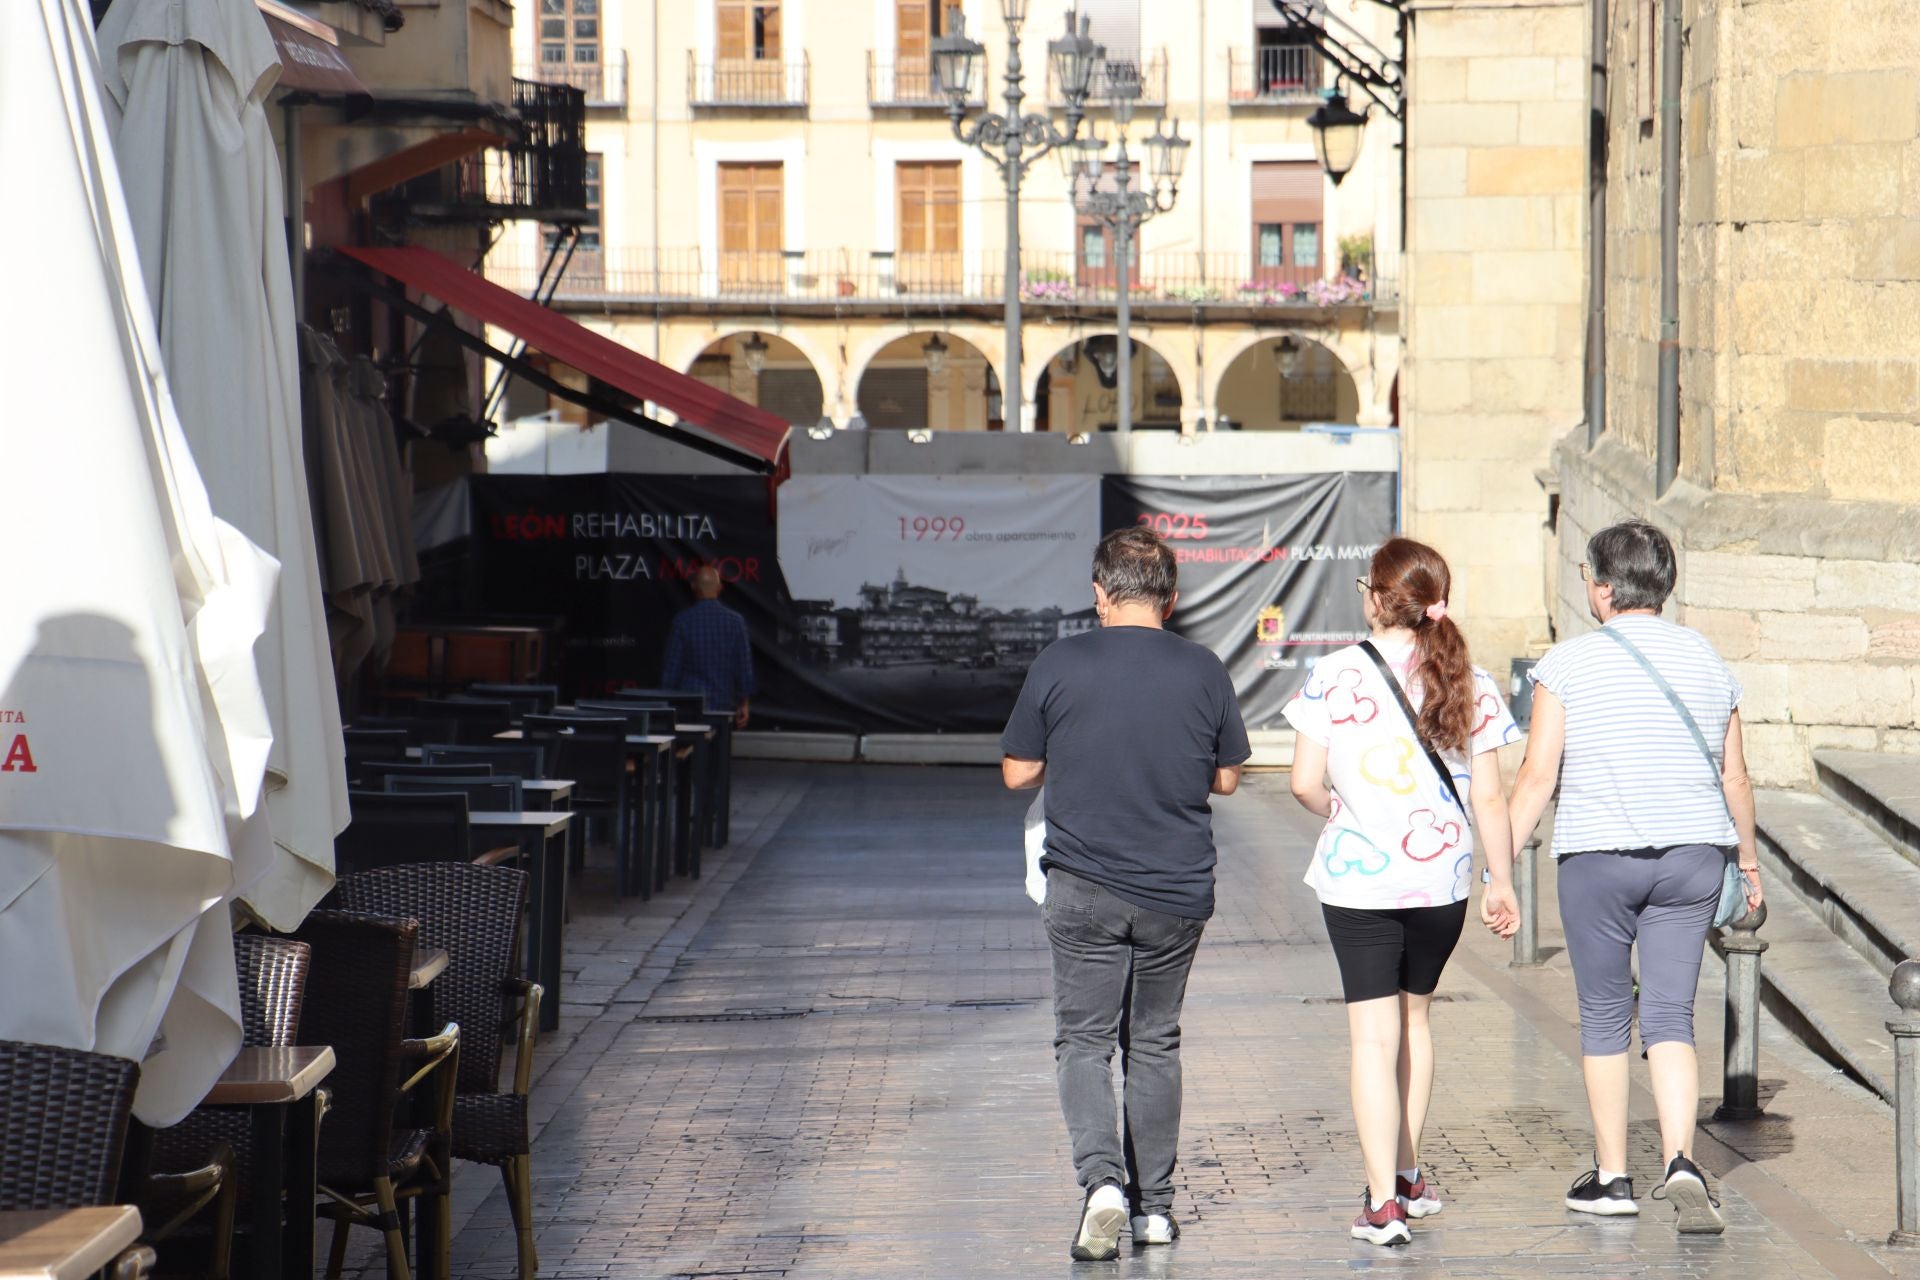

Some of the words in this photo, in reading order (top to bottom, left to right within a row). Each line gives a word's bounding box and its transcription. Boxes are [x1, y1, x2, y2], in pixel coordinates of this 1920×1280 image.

[491, 506, 566, 540] LEÓN
[572, 512, 717, 540] REHABILITA
[898, 516, 965, 542] 1999
[965, 531, 993, 542] obra
[996, 530, 1076, 544] aparcamiento
[1137, 512, 1209, 540] 2025
[575, 554, 652, 580] PLAZA
[1175, 546, 1287, 563] EHABILITACIÓN
[1290, 545, 1334, 561] PLAZA
[1289, 632, 1353, 642] AYUNTAMIENTO
